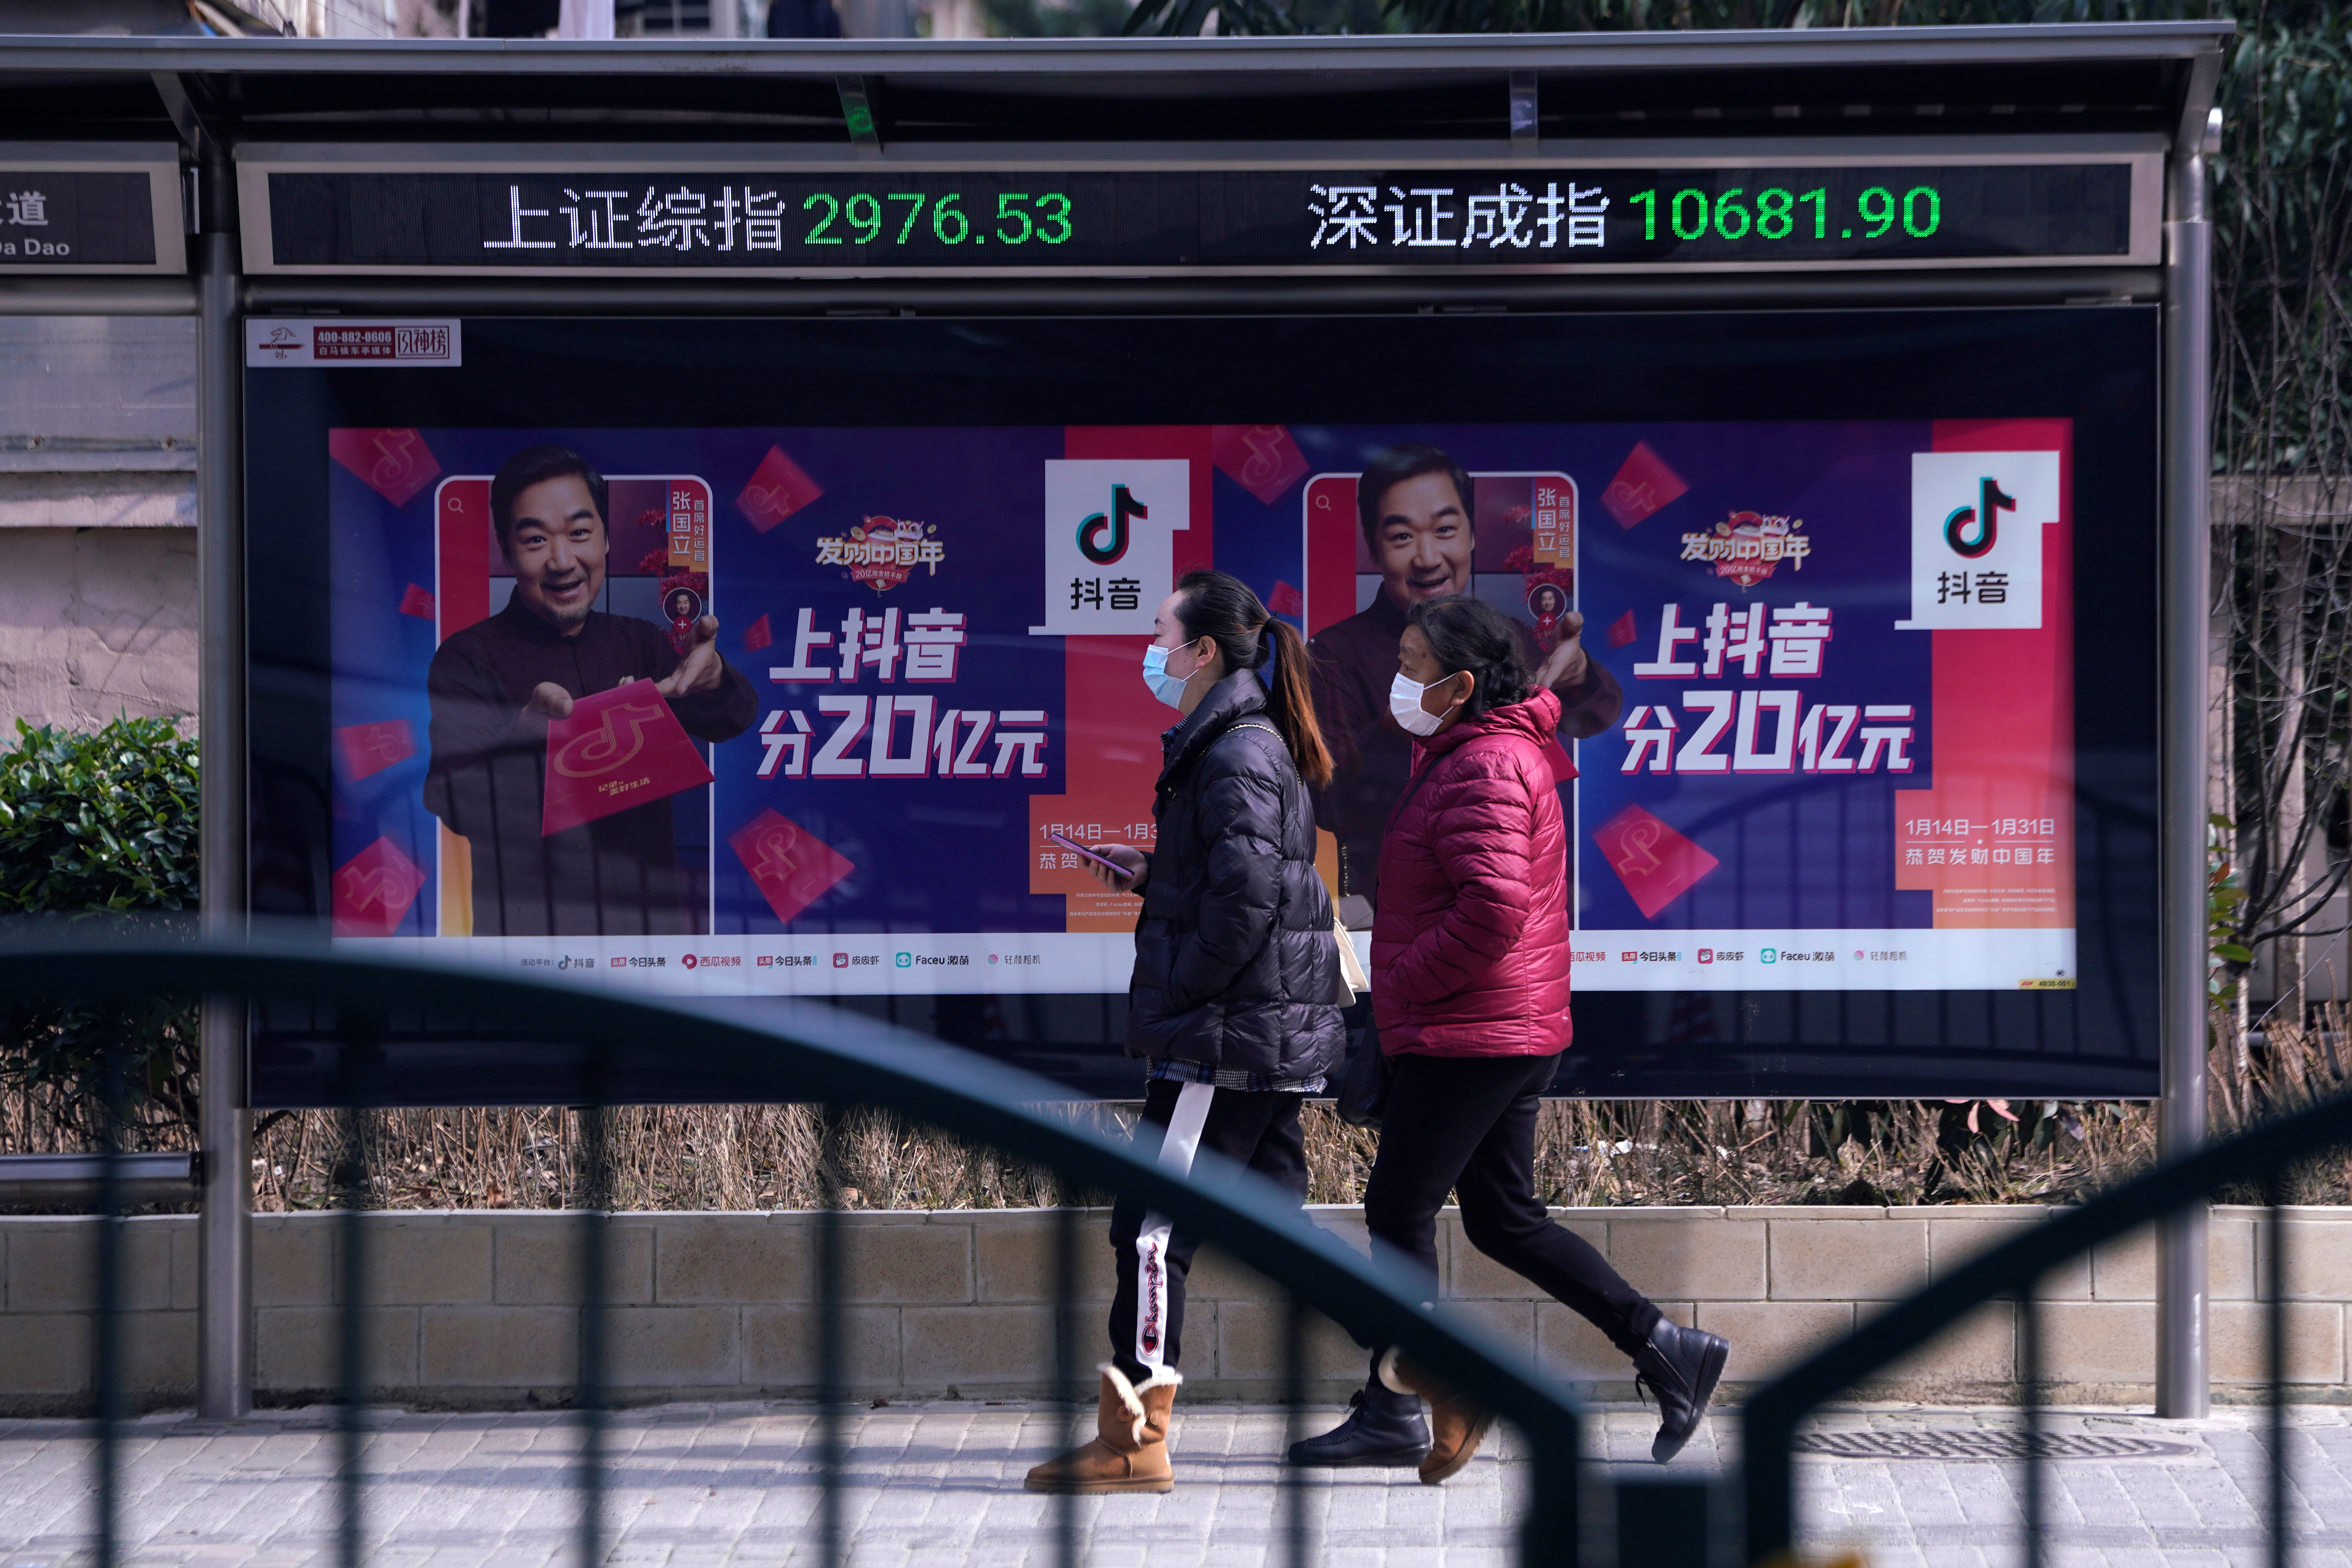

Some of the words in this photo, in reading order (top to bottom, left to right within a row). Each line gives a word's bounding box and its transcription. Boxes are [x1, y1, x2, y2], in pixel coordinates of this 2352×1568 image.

[0, 191, 49, 226] 道
[484, 185, 786, 252] 上证综指
[804, 193, 1073, 245] 2976.53
[1307, 182, 1611, 250] 深证成指
[1629, 186, 1942, 241] 10681.90
[0, 240, 16, 255] a
[24, 238, 70, 256] Dao
[318, 331, 392, 343] 400-882-0606
[673, 491, 691, 555] 张国立
[694, 500, 705, 562] 首席好运官
[1538, 488, 1556, 552] 张国立
[1559, 497, 1570, 559] 首席好运官
[815, 537, 945, 577] 发财中国年
[1679, 533, 1811, 572] 发财中国年
[855, 570, 902, 581] 20亿现金抢不停
[1938, 571, 2009, 604] 抖音
[1071, 578, 1141, 611] 抖音
[769, 608, 965, 682] 上抖音
[1633, 602, 1831, 677] 上抖音
[757, 695, 1047, 778] 分20亿元
[1621, 690, 1914, 773] 分20亿元
[1040, 853, 1078, 869] 恭贺
[1906, 848, 2054, 865] 恭贺发财中国年
[574, 958, 595, 968] 抖音
[629, 957, 666, 967] 今日头条
[700, 957, 741, 967] 西瓜视频
[775, 956, 812, 966] 今日头条
[852, 956, 879, 965] 皮皮虾
[916, 955, 945, 965] Faceu
[947, 956, 969, 965] 激萌
[1004, 955, 1041, 965] 轻颜相机
[1640, 952, 1676, 962] 今日头条
[1717, 952, 1744, 962] 皮皮虾
[1781, 951, 1811, 961] Faceu
[1813, 952, 1835, 962] 激萌
[1870, 951, 1907, 961] 轻颜相机
[1141, 1242, 1163, 1356] Champion
